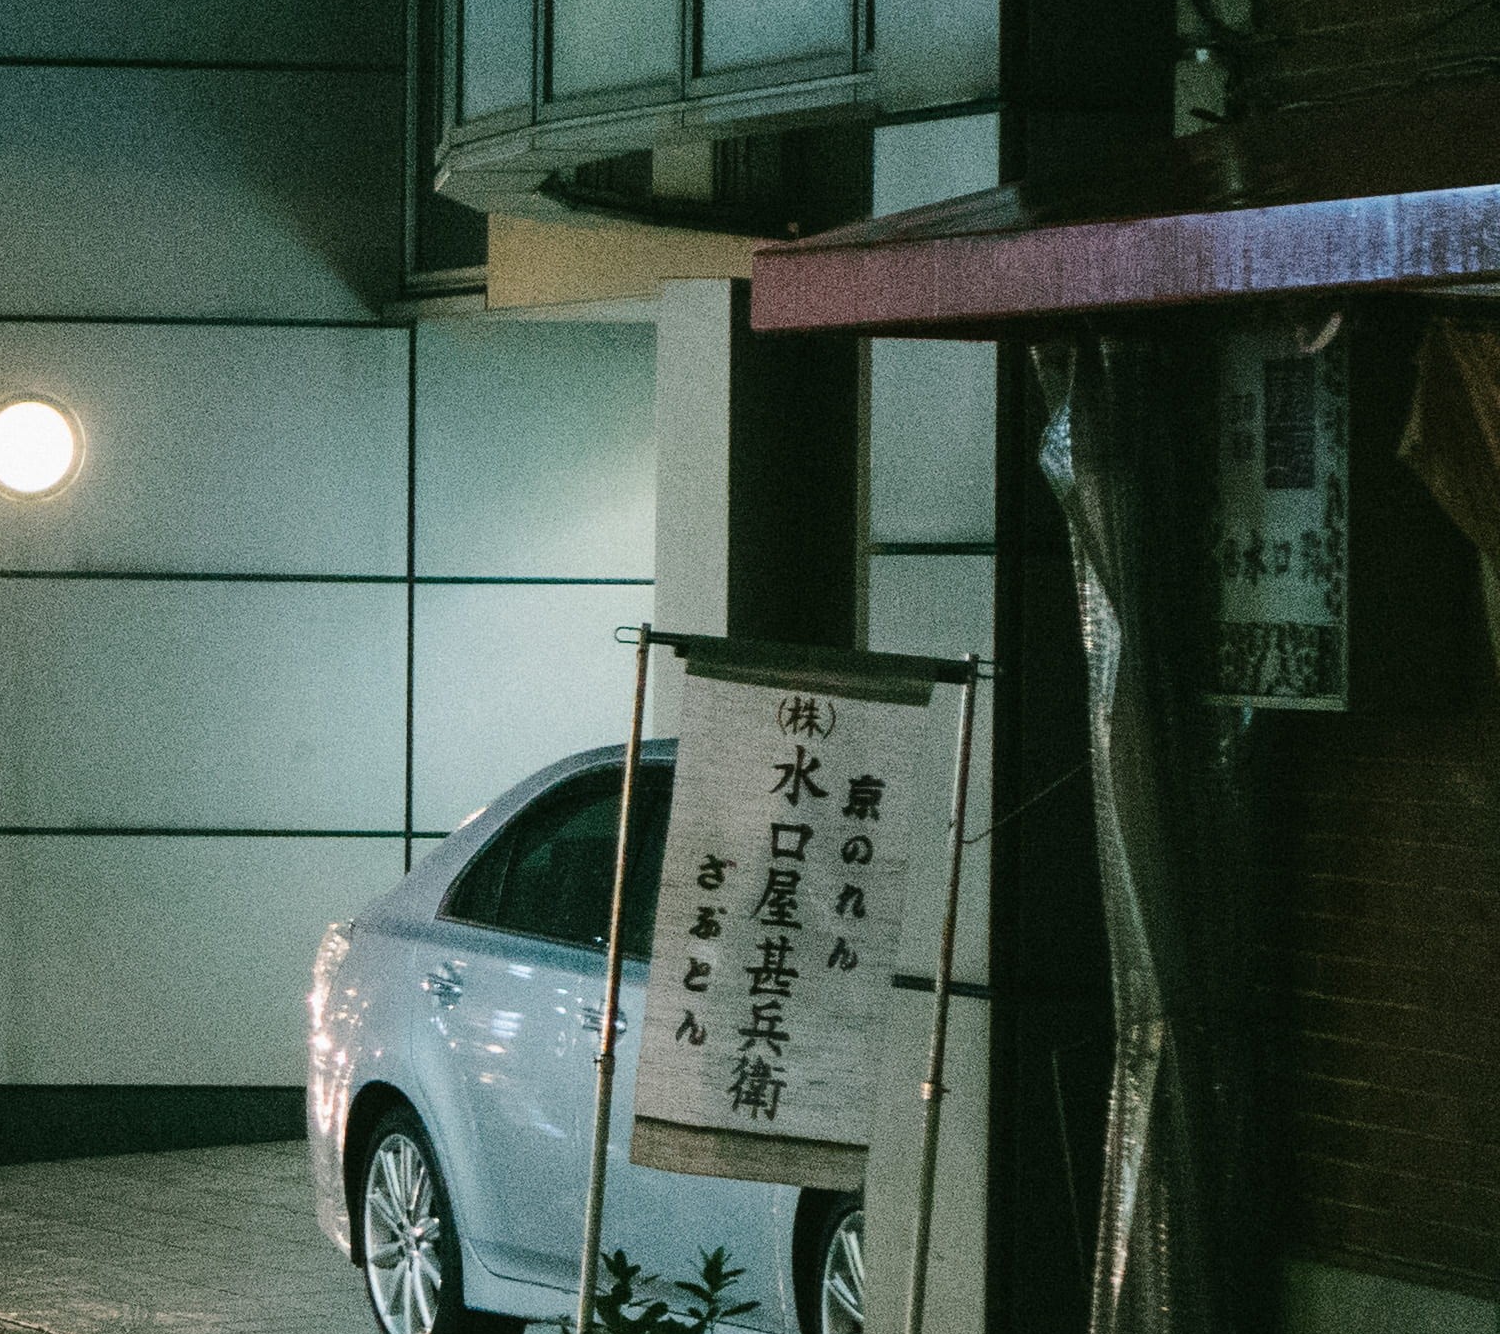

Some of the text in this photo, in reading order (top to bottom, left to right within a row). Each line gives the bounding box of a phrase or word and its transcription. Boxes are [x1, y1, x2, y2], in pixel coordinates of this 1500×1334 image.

[675, 854, 738, 1046] ざぶとん
[827, 774, 886, 971] 京のれん
